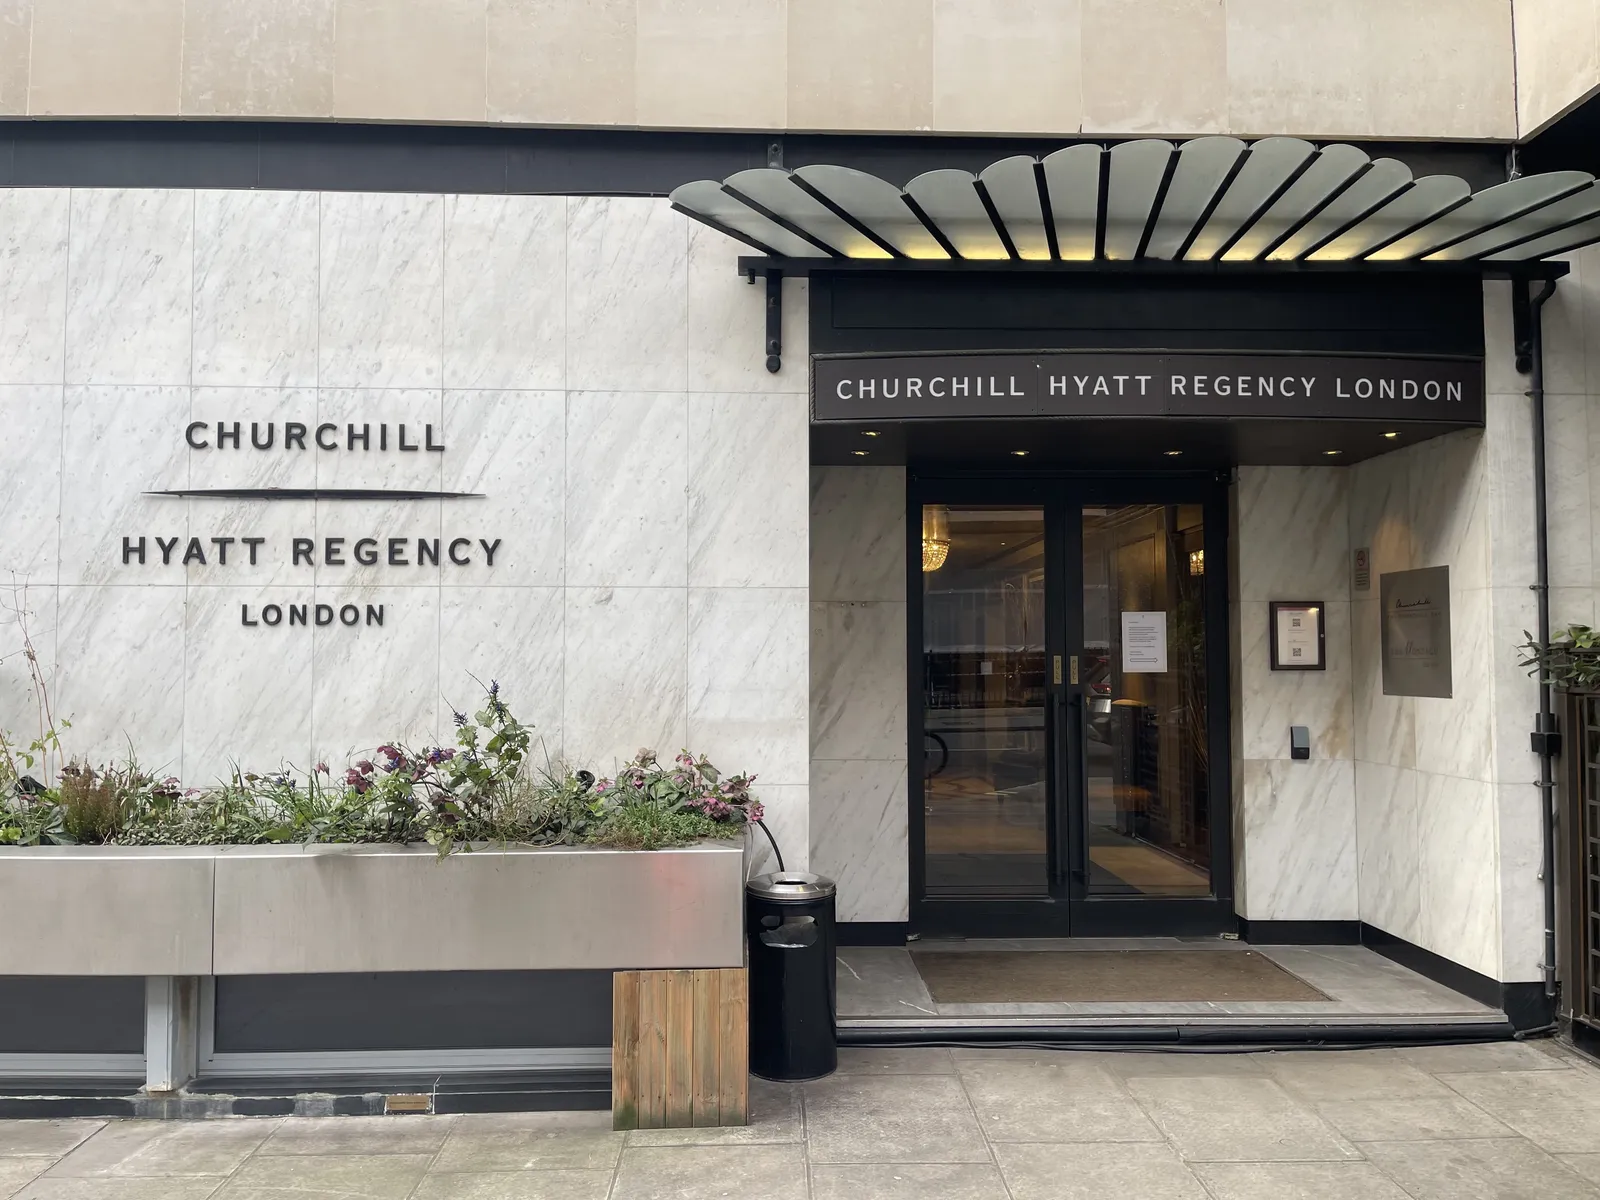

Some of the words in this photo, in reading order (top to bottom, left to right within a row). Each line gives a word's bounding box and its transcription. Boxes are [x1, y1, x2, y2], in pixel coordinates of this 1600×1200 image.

[836, 376, 1025, 400] CHURCHILL
[1049, 375, 1152, 396] HYATT
[1171, 375, 1316, 397] REGENCY
[1336, 377, 1463, 403] LONDON
[185, 421, 446, 453] CHURCHILL
[122, 536, 265, 566] HYATT
[292, 537, 503, 567] REGENCY
[241, 604, 384, 627] LONDON
